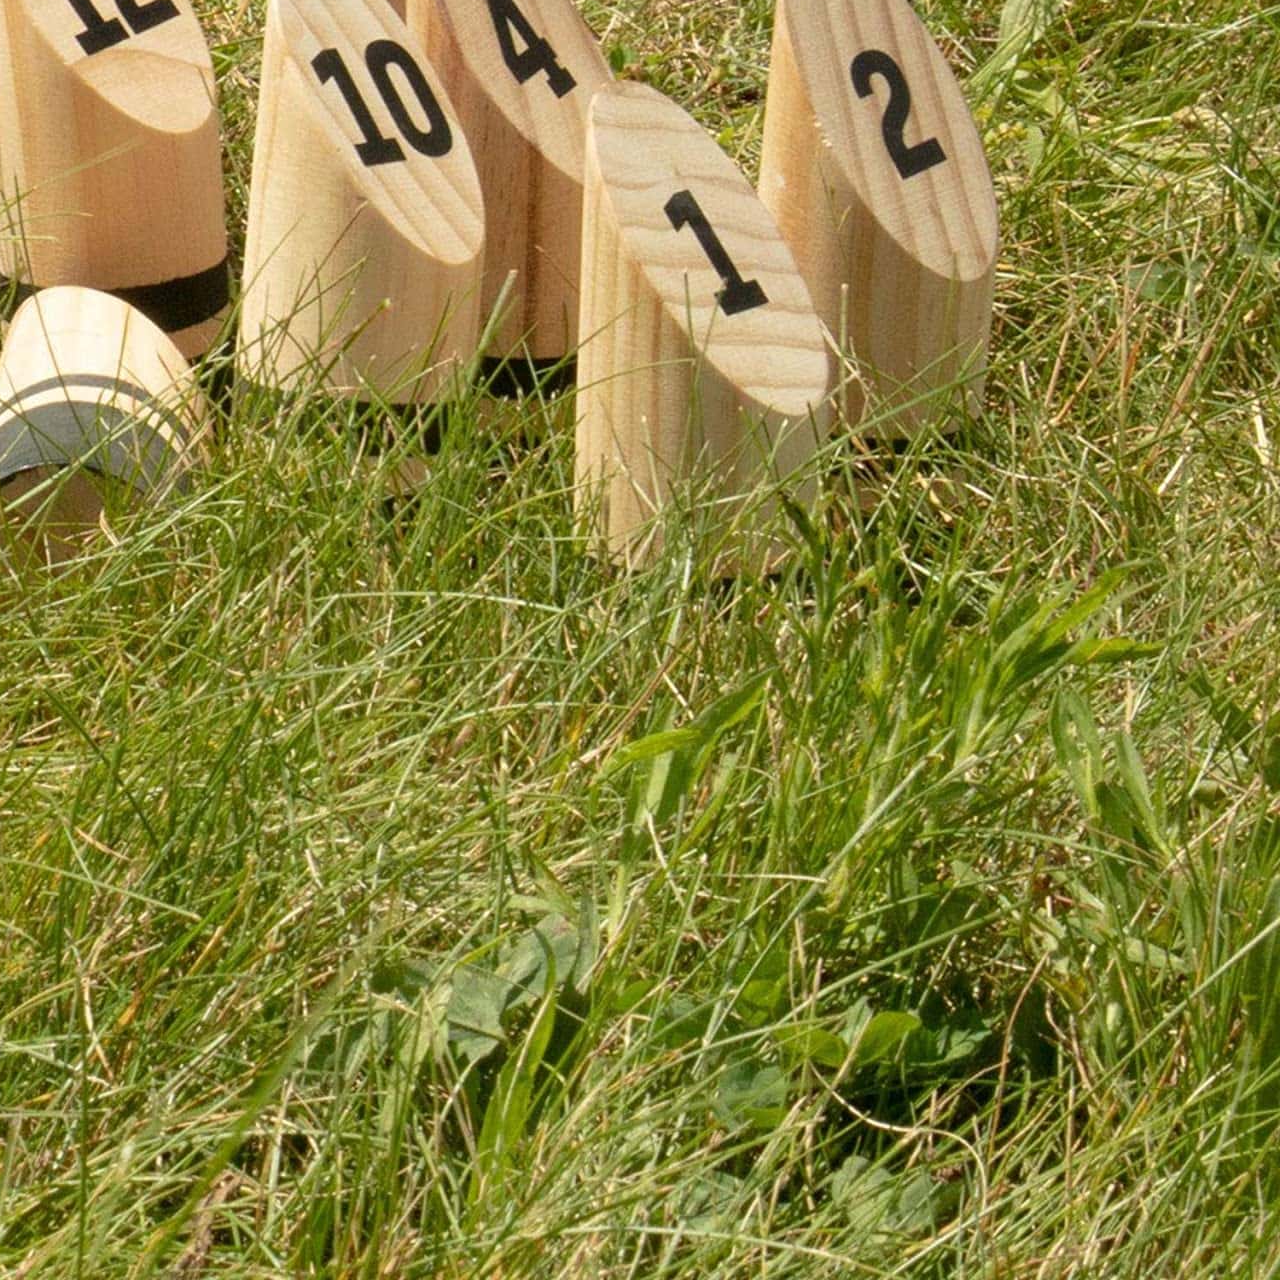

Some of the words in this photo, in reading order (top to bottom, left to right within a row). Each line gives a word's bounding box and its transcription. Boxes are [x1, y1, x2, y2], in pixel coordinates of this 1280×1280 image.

[311, 39, 453, 166] 10
[850, 49, 947, 180] 2
[663, 190, 769, 316] 1
